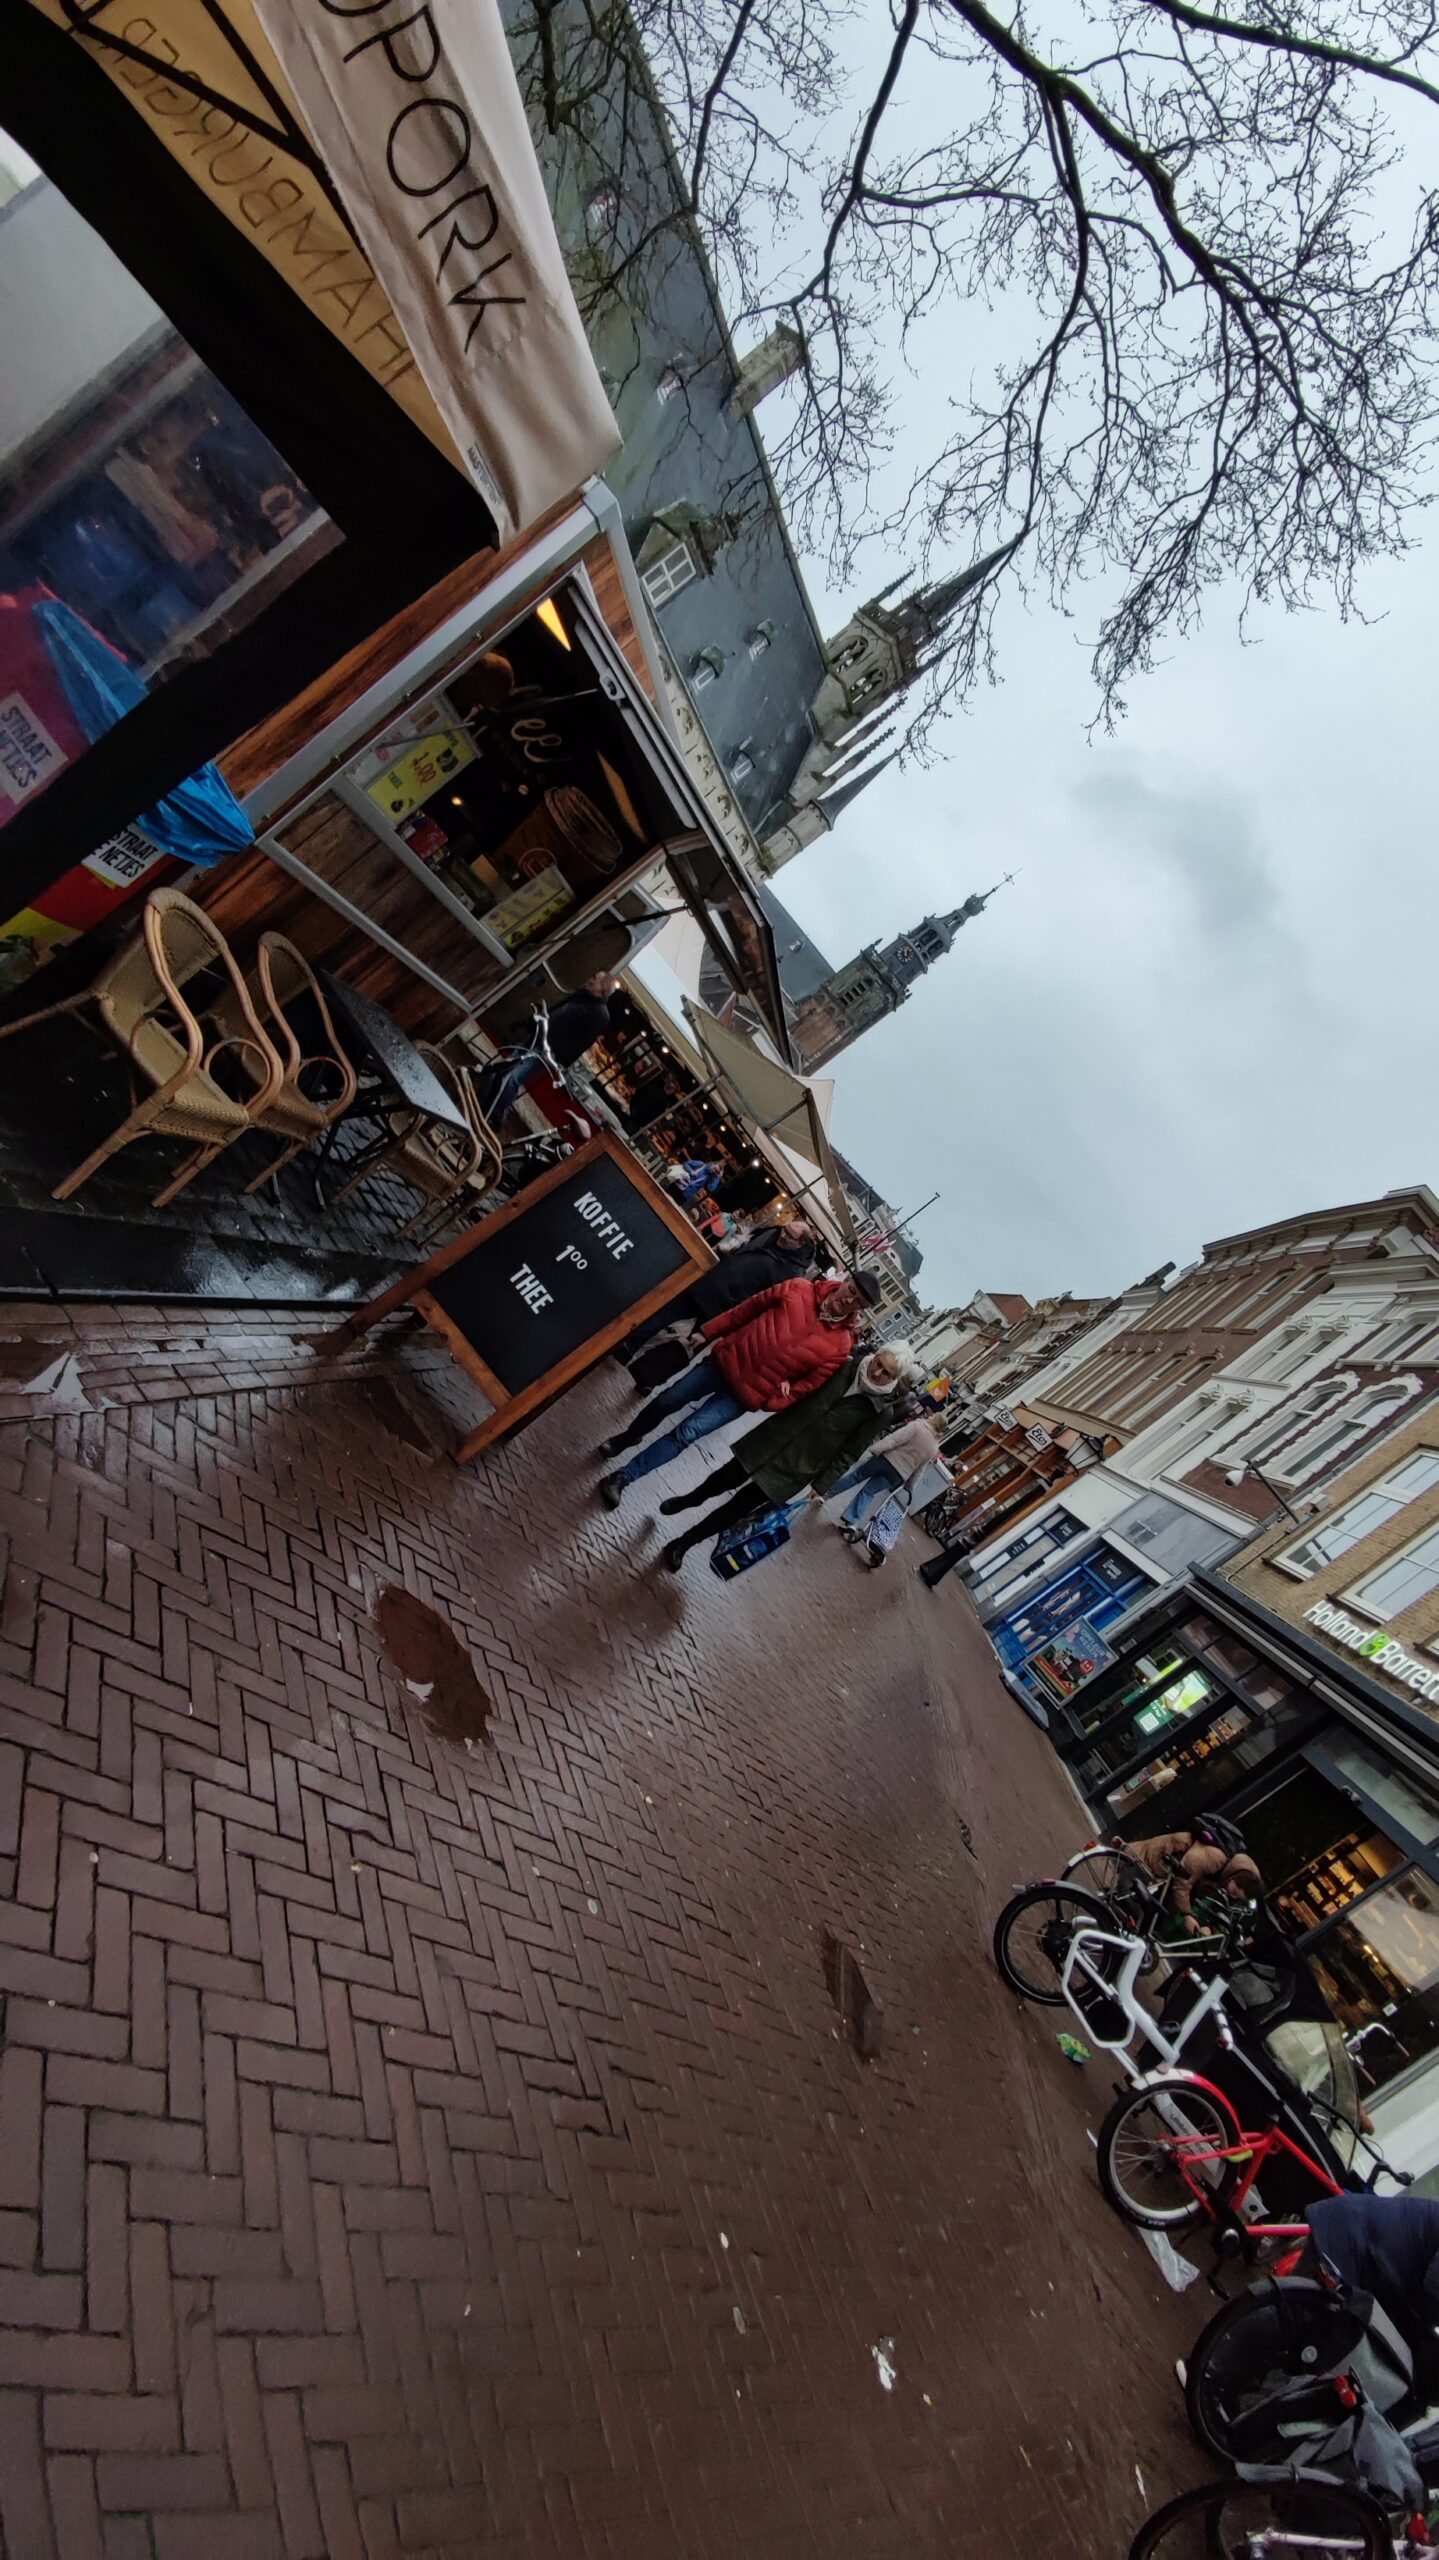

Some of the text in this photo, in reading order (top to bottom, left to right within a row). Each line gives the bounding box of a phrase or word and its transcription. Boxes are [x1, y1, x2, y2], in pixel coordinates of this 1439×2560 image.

[2, 706, 52, 765] STRAAT
[98, 846, 145, 878] NETJES
[112, 828, 159, 860] STRAAT
[573, 1191, 634, 1260] KOFFIE
[510, 1263, 554, 1315] THEE
[1031, 1428, 1047, 1446] Etos
[1302, 1599, 1378, 1651] Holland
